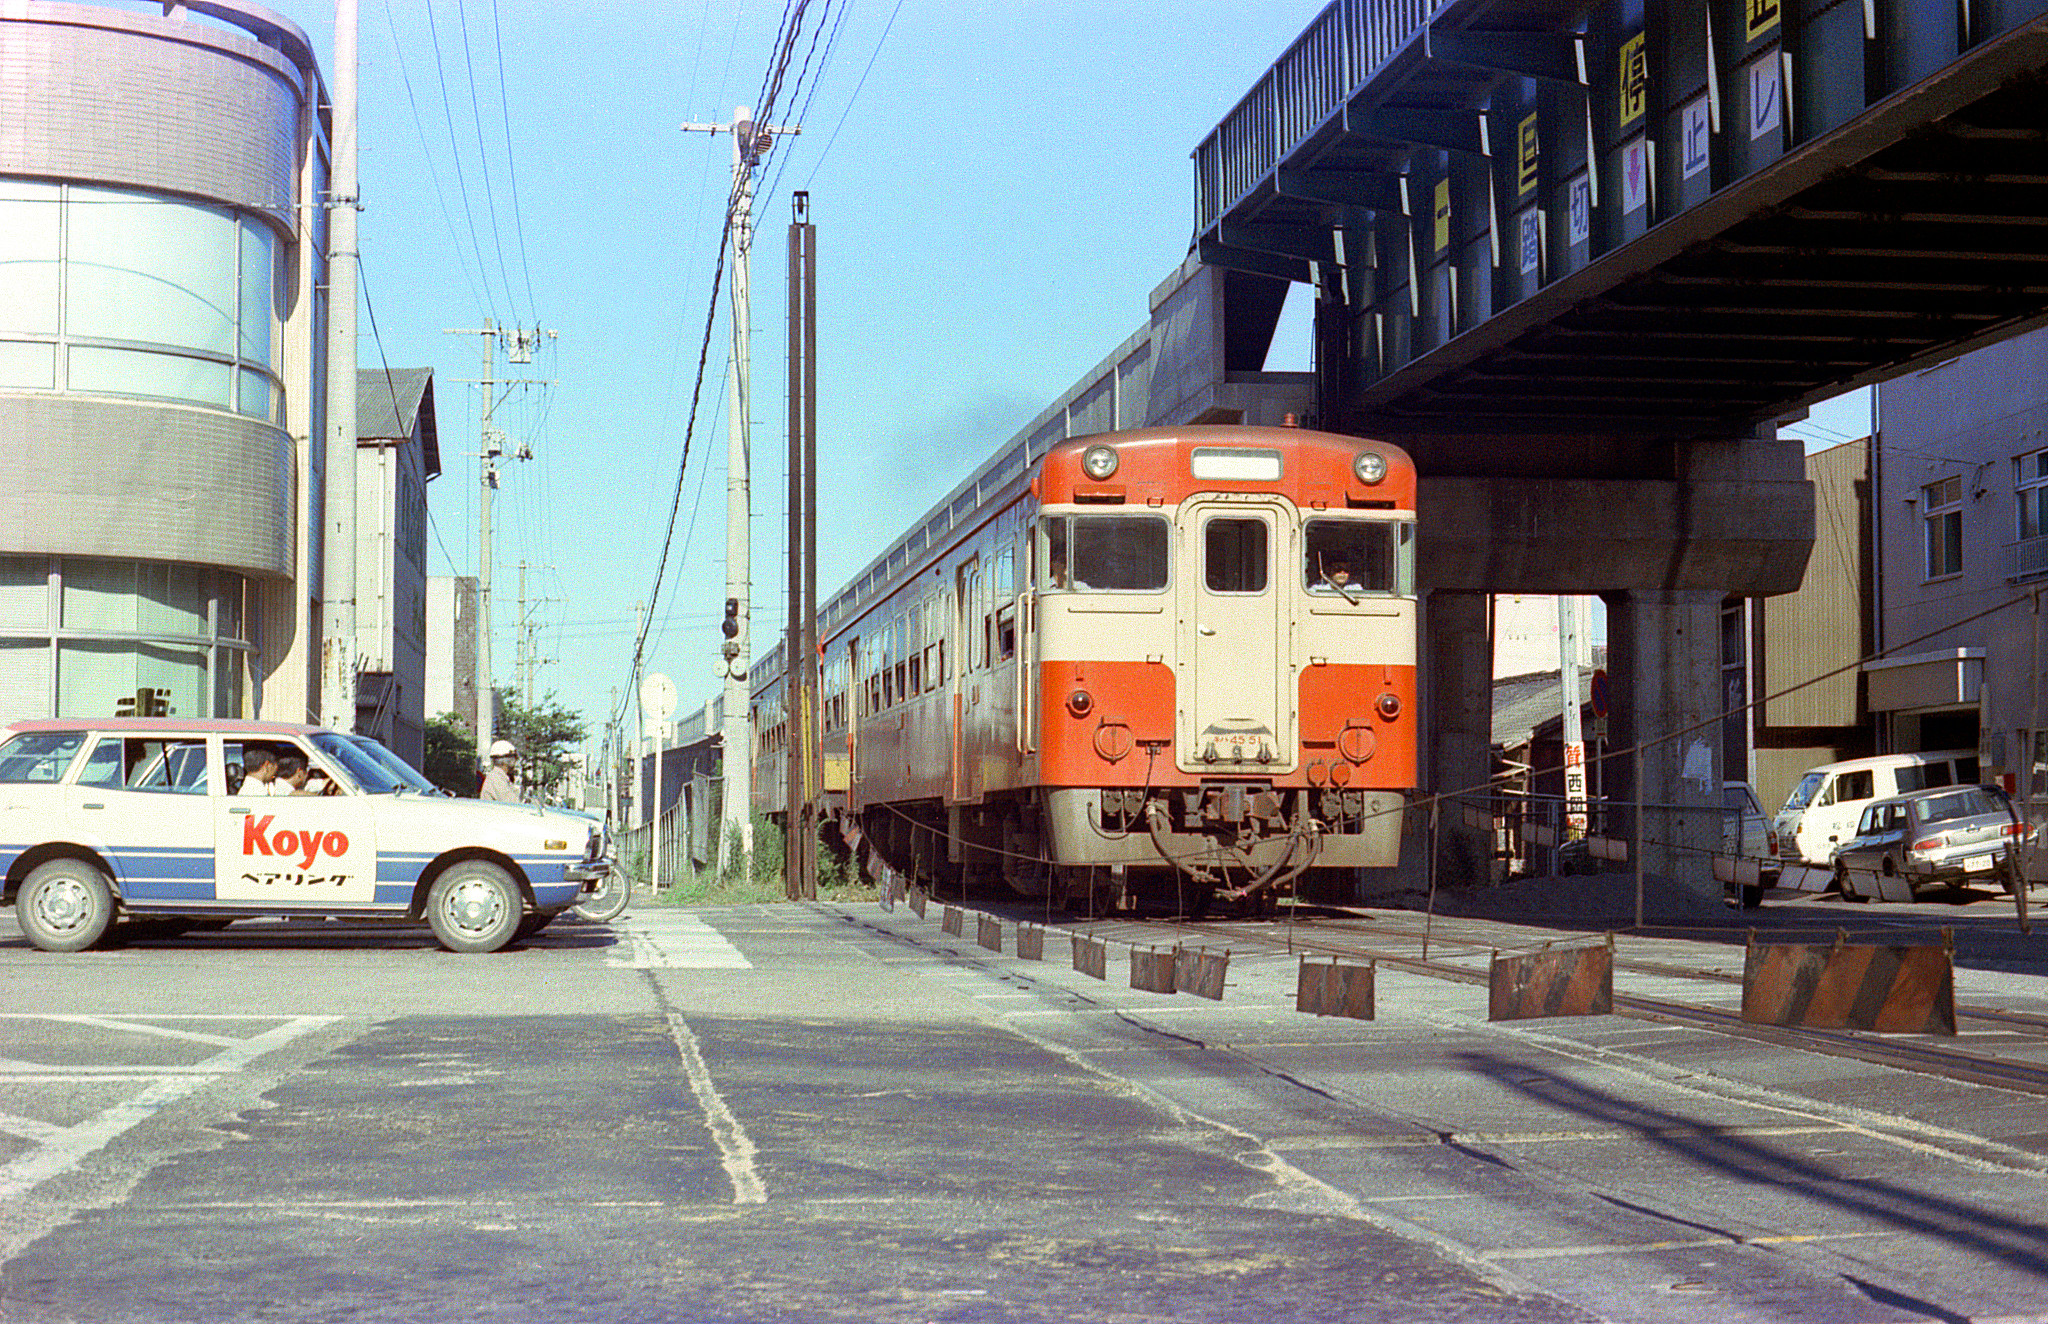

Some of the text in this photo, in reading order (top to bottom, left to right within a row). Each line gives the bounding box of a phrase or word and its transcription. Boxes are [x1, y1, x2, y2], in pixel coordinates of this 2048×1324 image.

[1621, 40, 1646, 118] 停
[1571, 181, 1589, 236] 切
[1685, 111, 1706, 171] 止
[243, 814, 350, 871] Koyo
[241, 873, 354, 887] ベアリング
